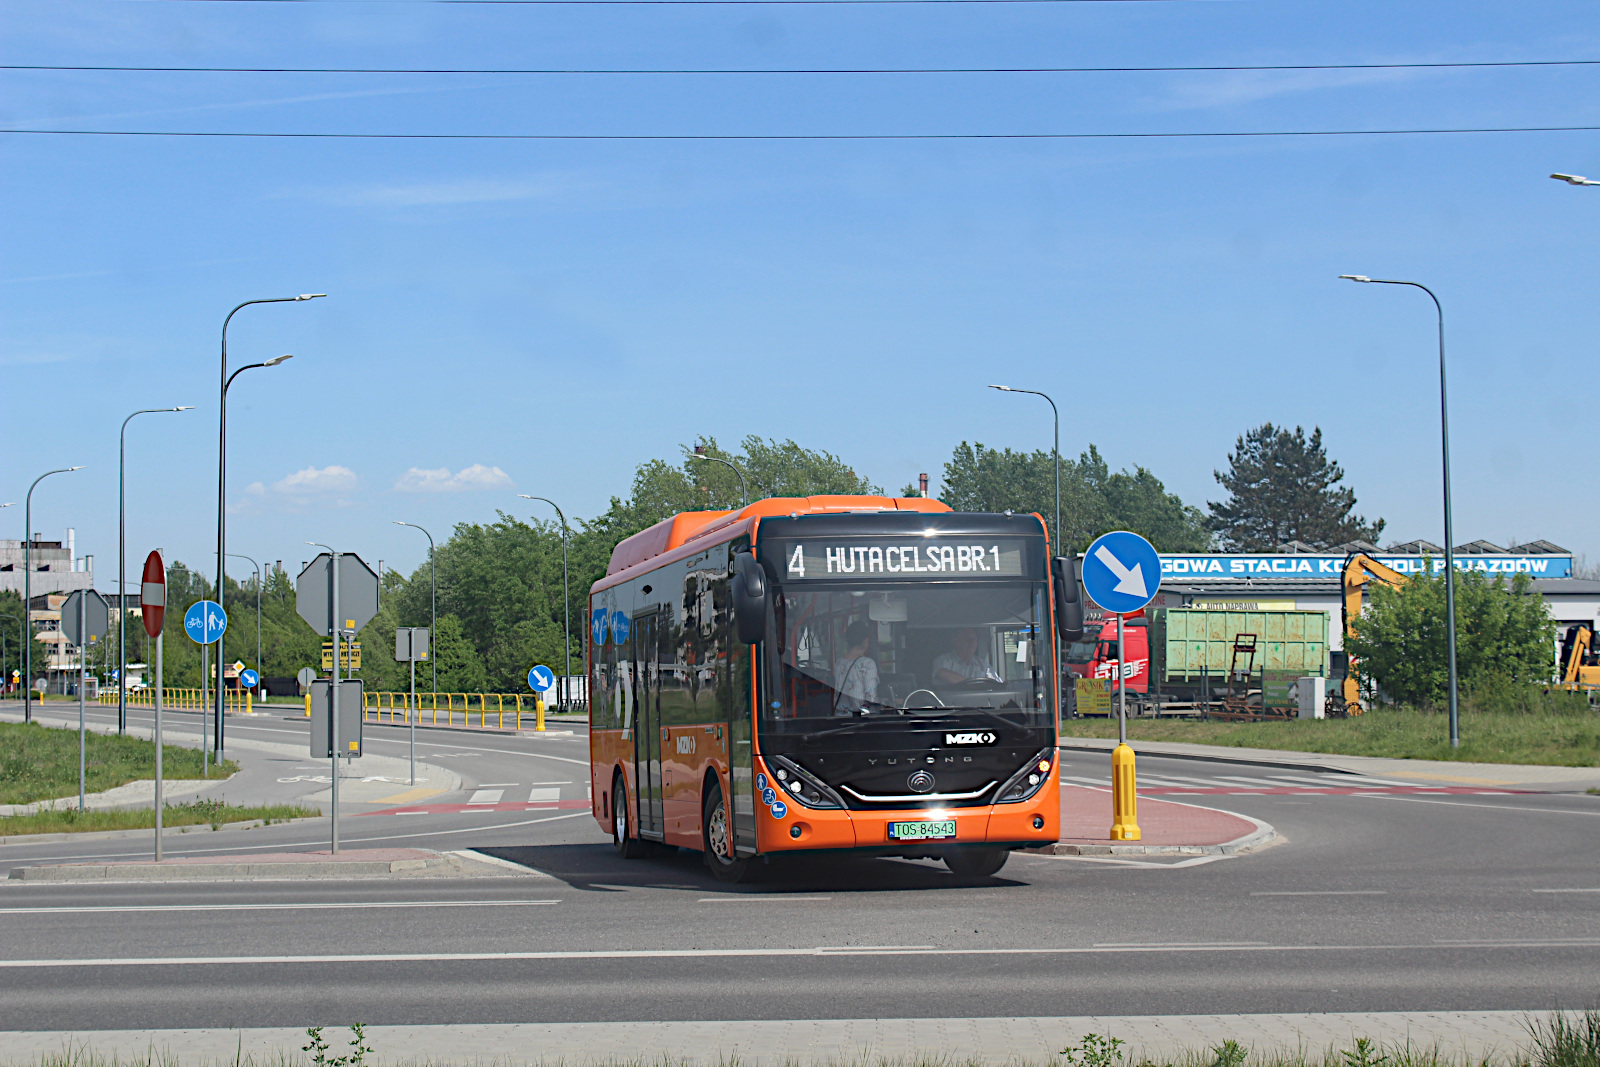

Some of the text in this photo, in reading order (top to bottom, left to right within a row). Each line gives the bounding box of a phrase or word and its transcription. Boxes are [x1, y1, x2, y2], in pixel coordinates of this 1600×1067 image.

[788, 545, 1000, 577] 4 HUTA CELSA BR.1
[1161, 559, 1223, 573] GOWA
[1230, 559, 1312, 573] STACJA
[868, 756, 972, 765] YUTONG
[895, 822, 954, 836] TOS 84543
